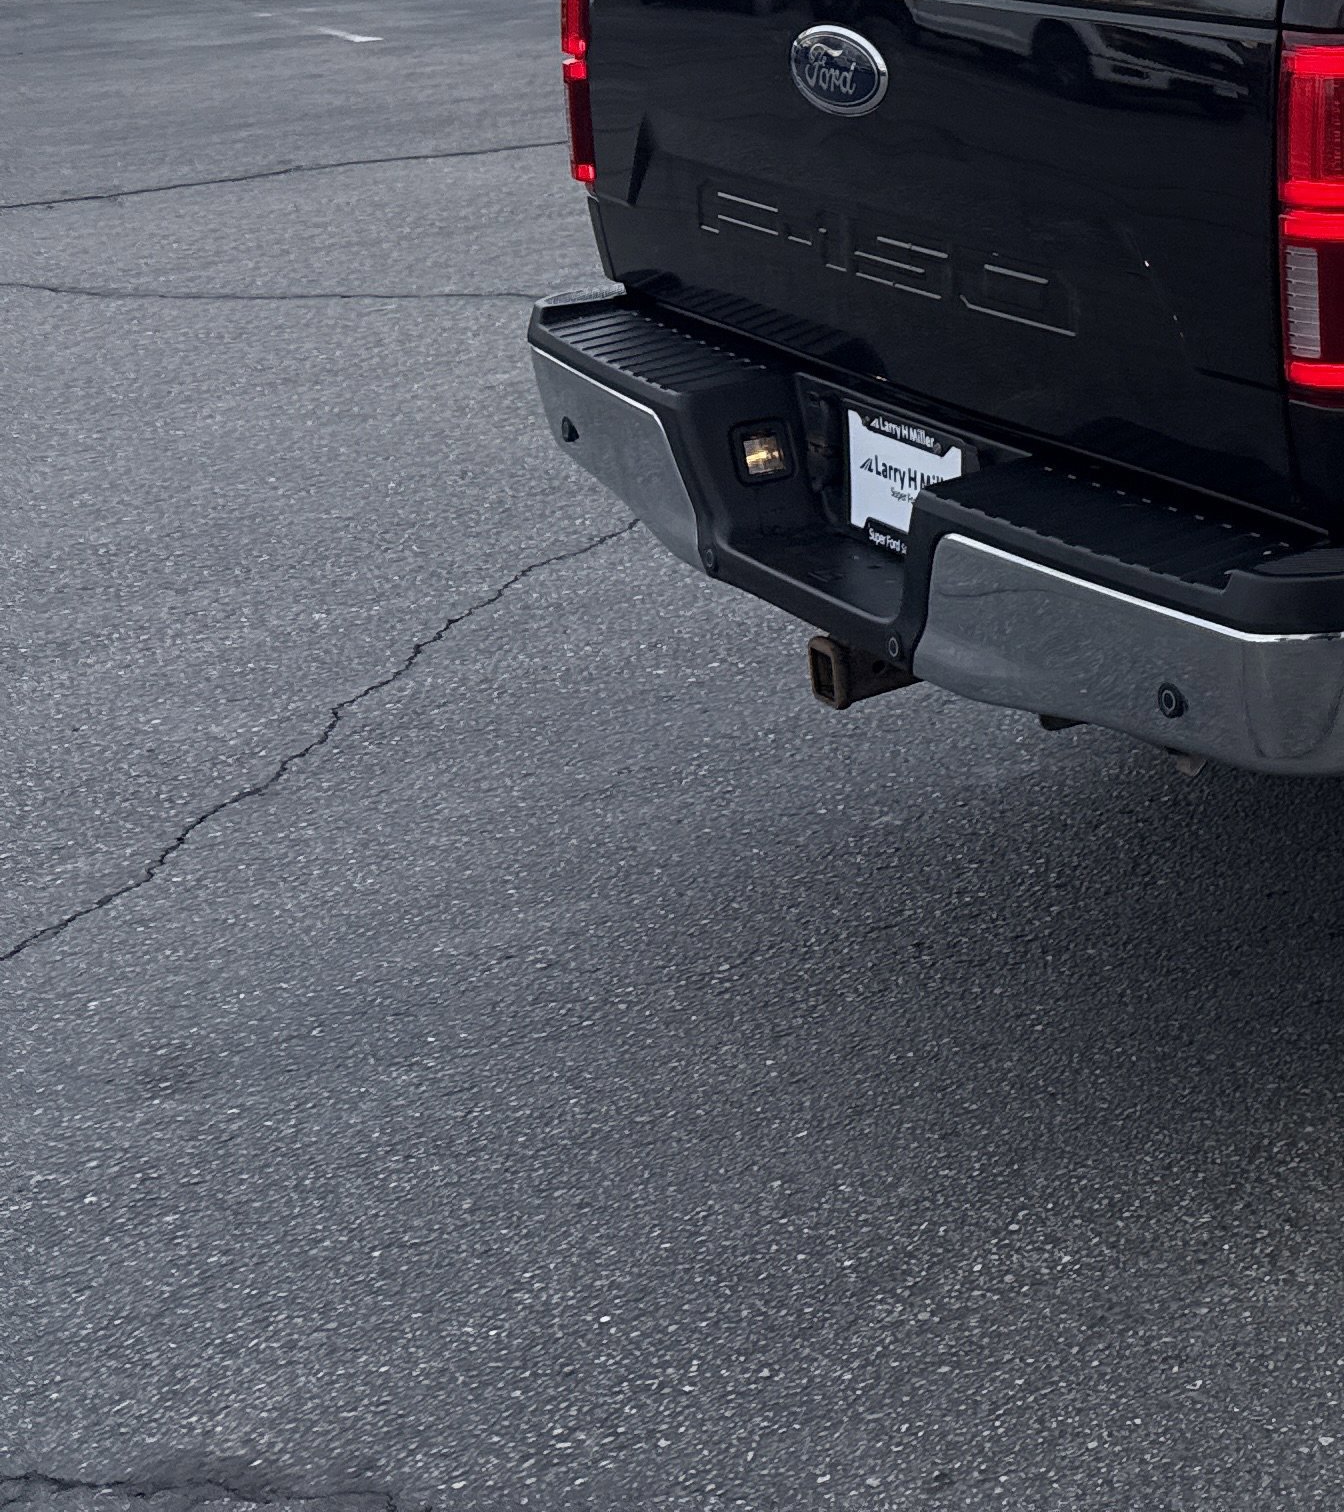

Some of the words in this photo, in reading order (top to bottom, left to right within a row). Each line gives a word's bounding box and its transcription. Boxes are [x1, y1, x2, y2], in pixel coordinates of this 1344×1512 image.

[804, 43, 857, 95] Ford
[879, 416, 901, 439] Larry
[901, 424, 909, 439] H
[909, 427, 935, 448] Miller
[874, 455, 907, 491] Larry
[907, 467, 918, 490] H
